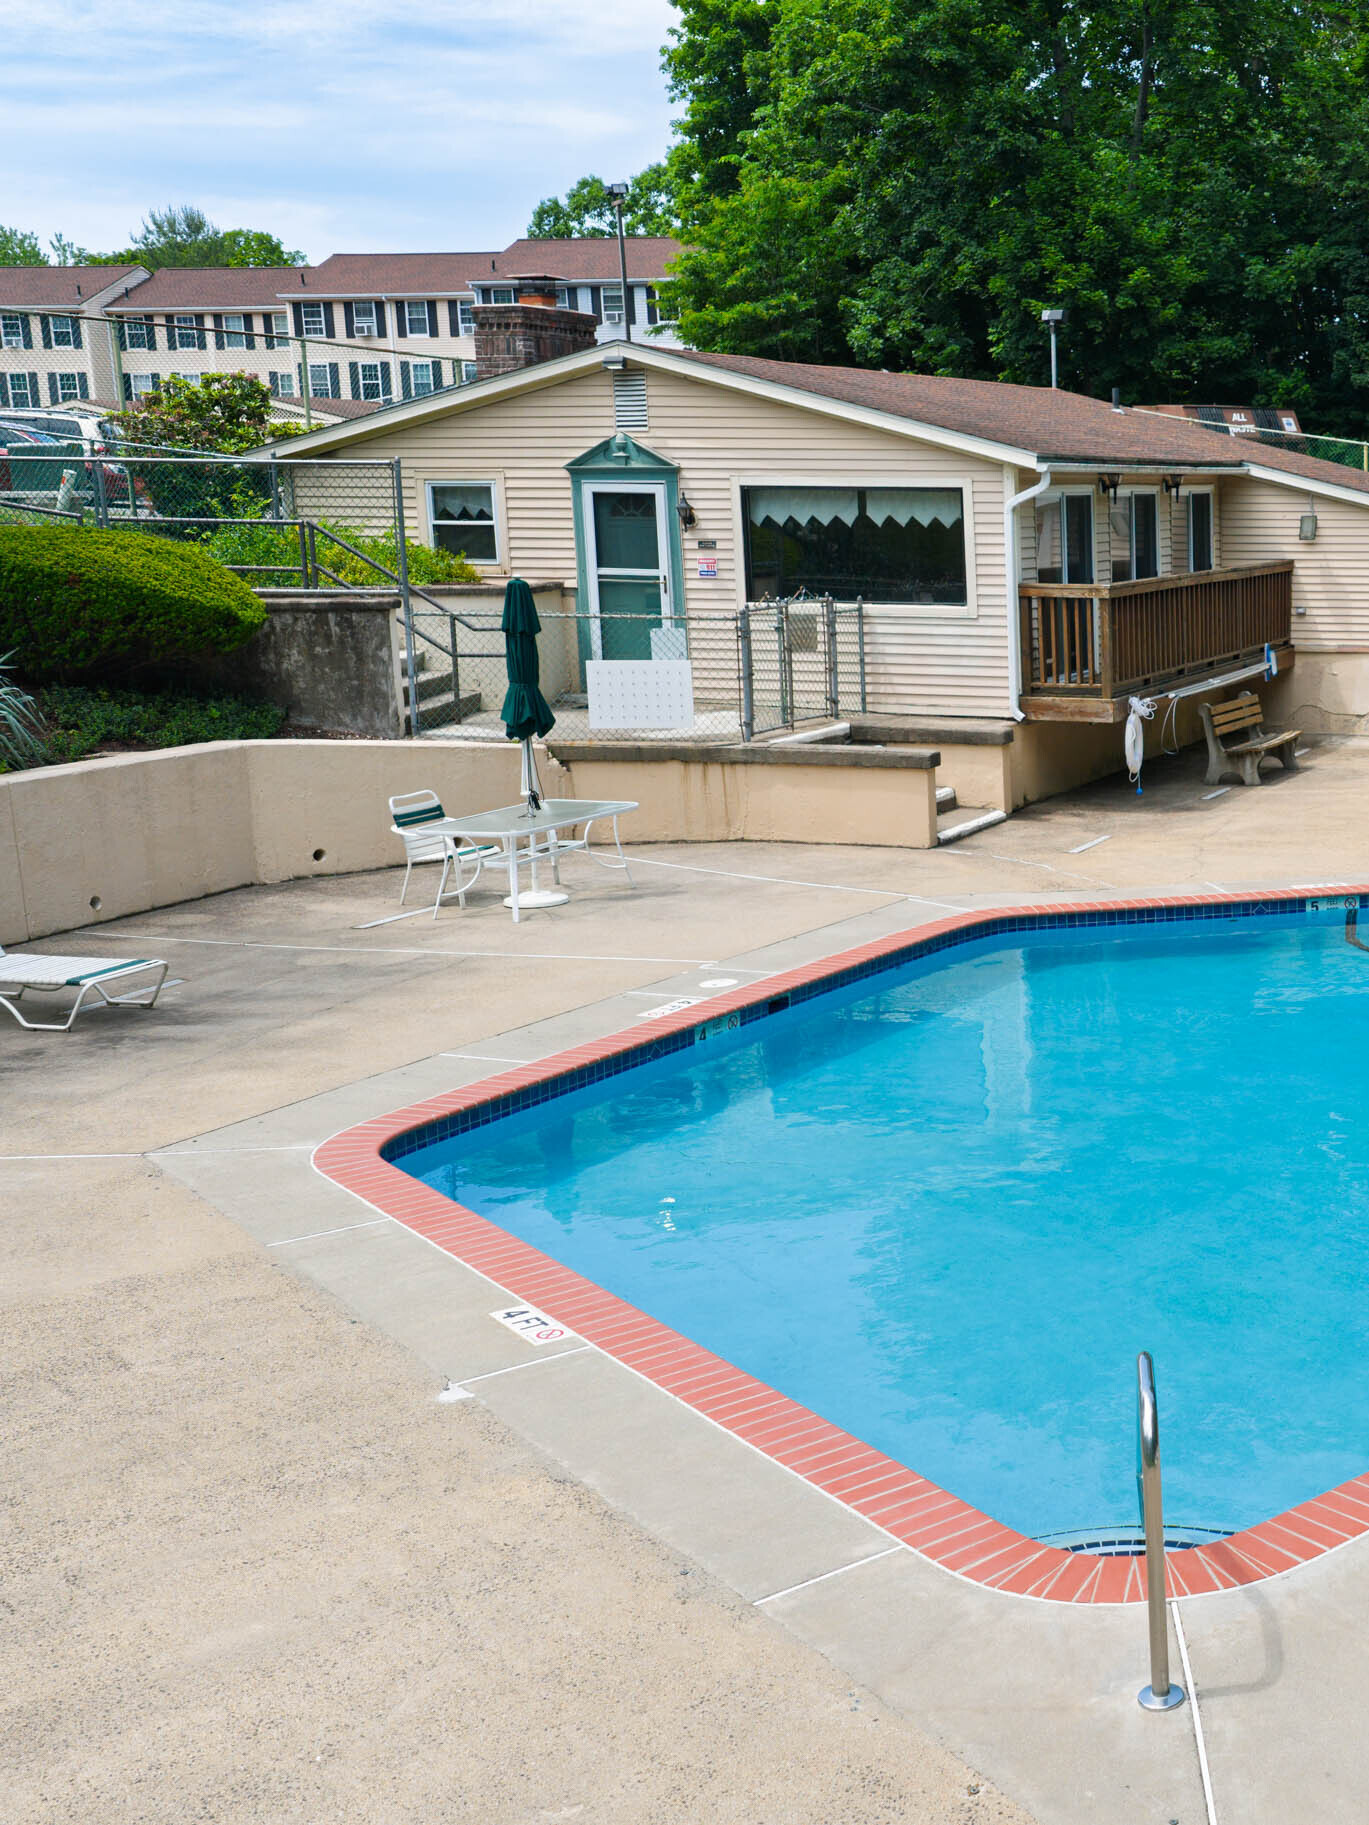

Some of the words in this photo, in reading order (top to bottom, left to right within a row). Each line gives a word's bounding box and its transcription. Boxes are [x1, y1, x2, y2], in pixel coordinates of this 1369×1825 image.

[1231, 412, 1247, 422] ALL
[1311, 901, 1319, 911] 5
[503, 1310, 530, 1319] 4
[512, 1316, 549, 1331] FT
